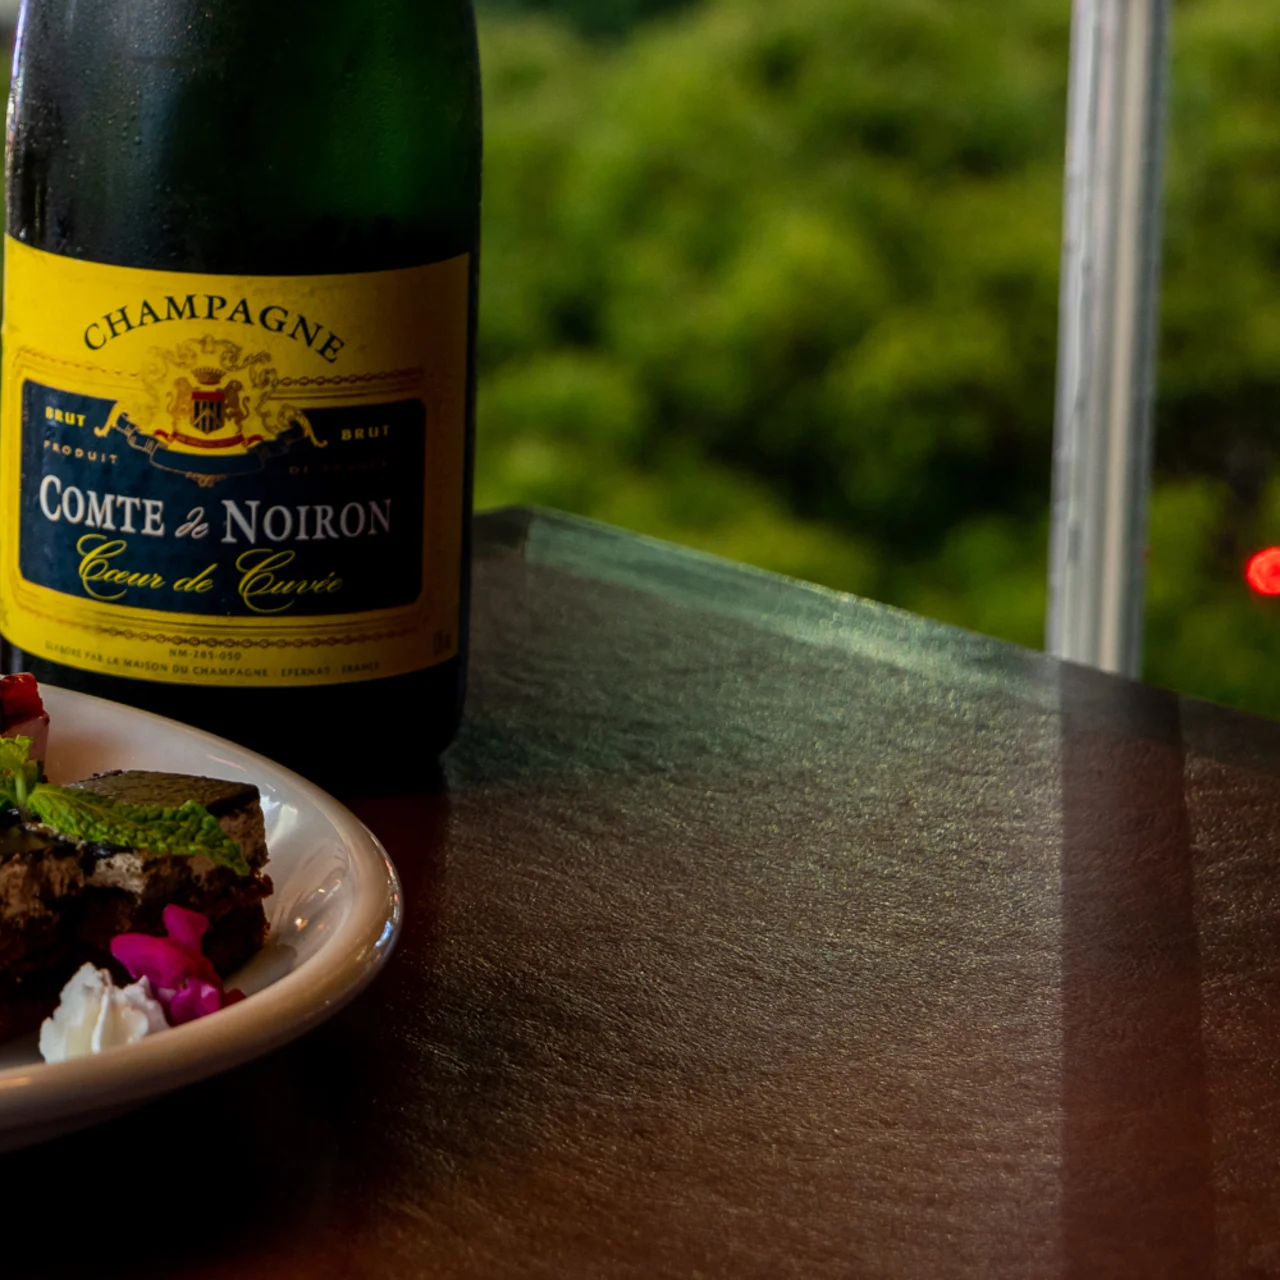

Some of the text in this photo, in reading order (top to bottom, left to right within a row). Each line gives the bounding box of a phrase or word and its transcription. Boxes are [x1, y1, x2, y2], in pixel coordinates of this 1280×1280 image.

[83, 293, 346, 364] CHAMPAGNE
[44, 405, 87, 428] BRUT
[340, 423, 391, 442] BRUT
[43, 438, 119, 465] PRODUIT
[39, 474, 166, 537] COMTE
[220, 497, 392, 545] NOIRON
[172, 562, 219, 593] de
[235, 547, 343, 614] Cuvée
[107, 655, 121, 666] LA
[123, 658, 168, 672] MAISON
[172, 664, 189, 675] DU
[192, 665, 268, 678] CHAMPAGNE
